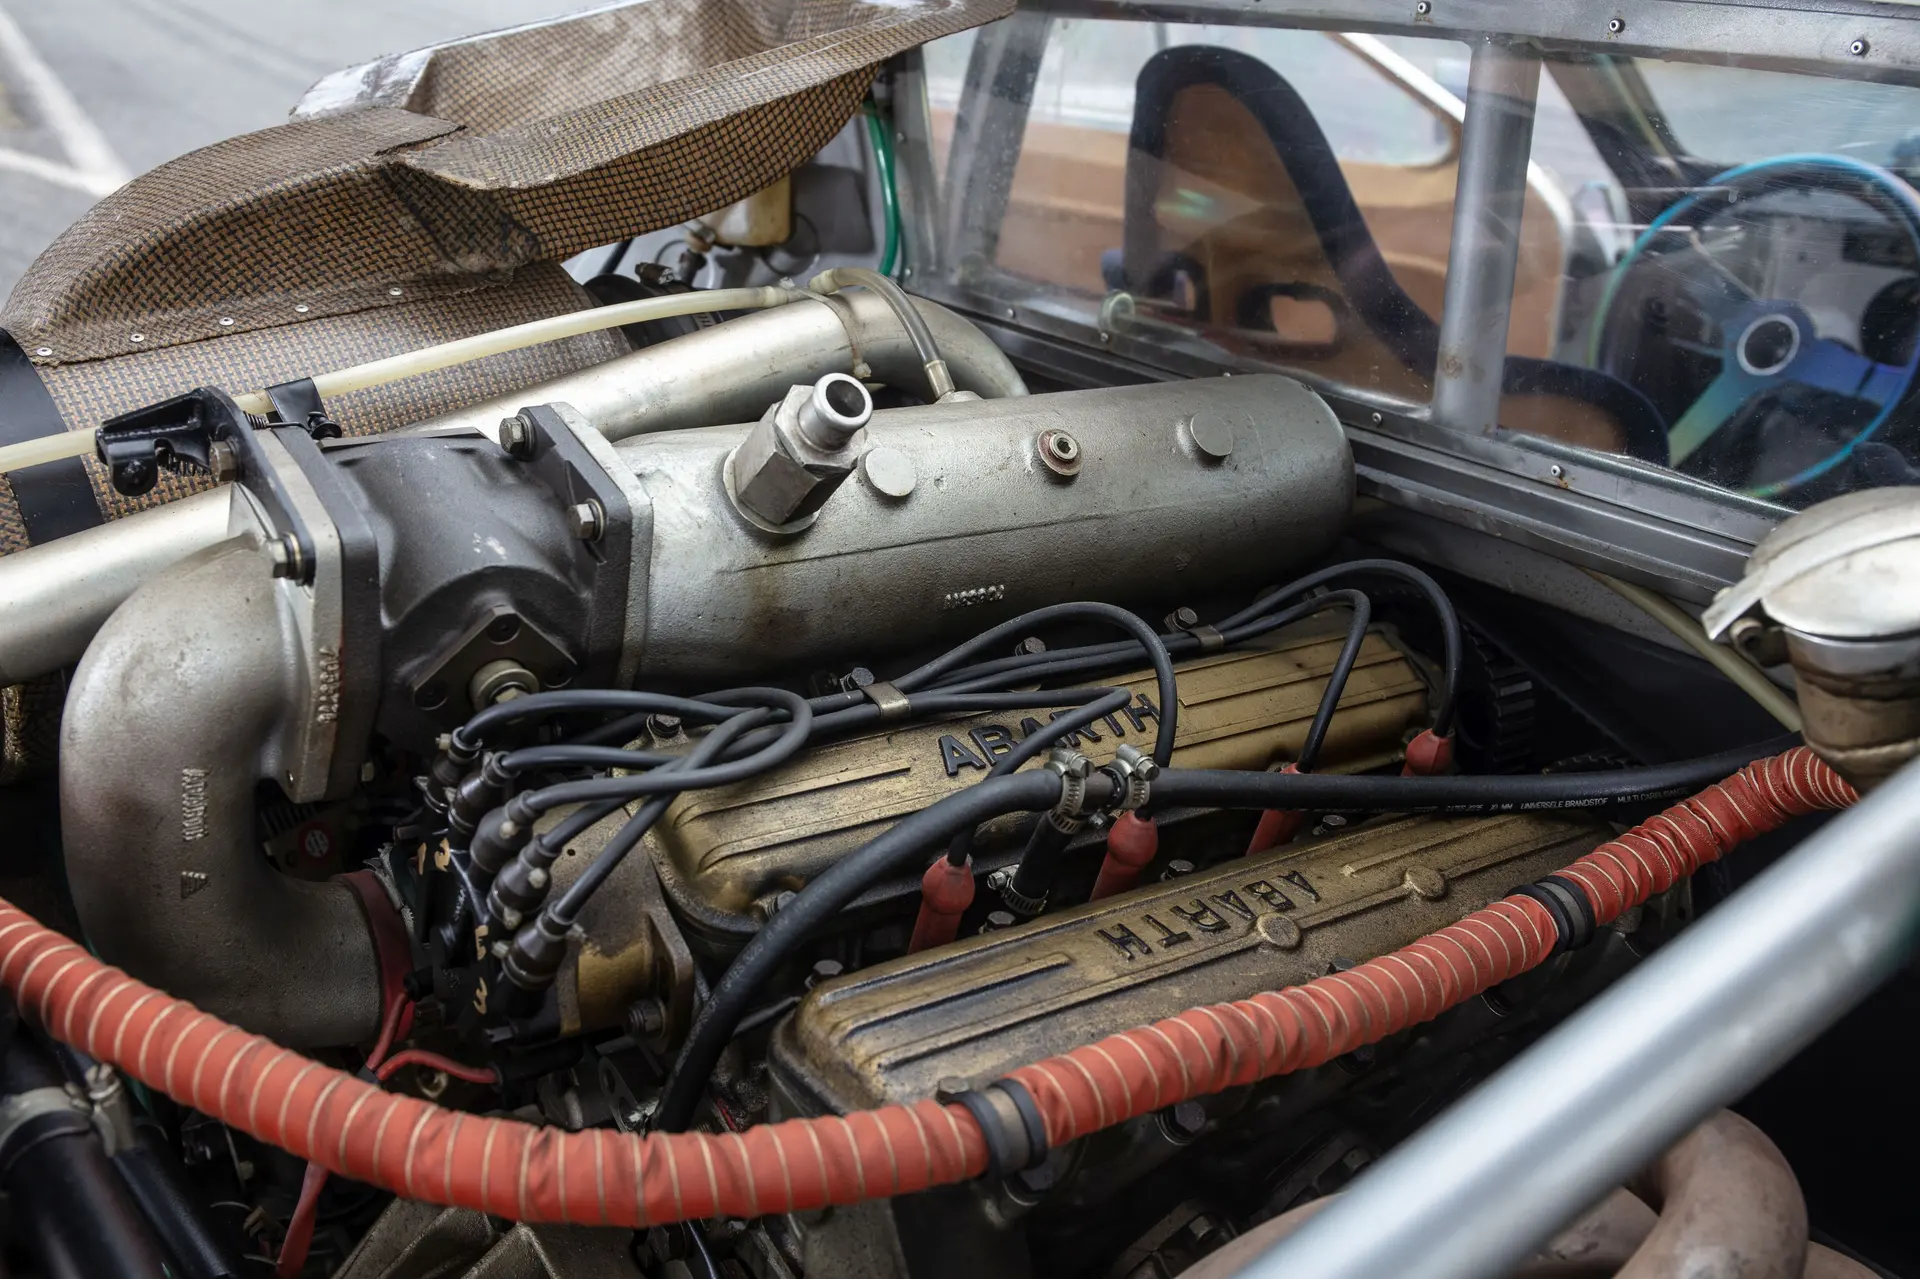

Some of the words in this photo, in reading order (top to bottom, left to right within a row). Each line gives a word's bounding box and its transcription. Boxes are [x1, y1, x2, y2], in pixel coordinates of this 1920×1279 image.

[1565, 797, 1609, 808] BRANDSTOF
[1617, 794, 1640, 804] MULTI
[1092, 871, 1321, 963] ABARTH
